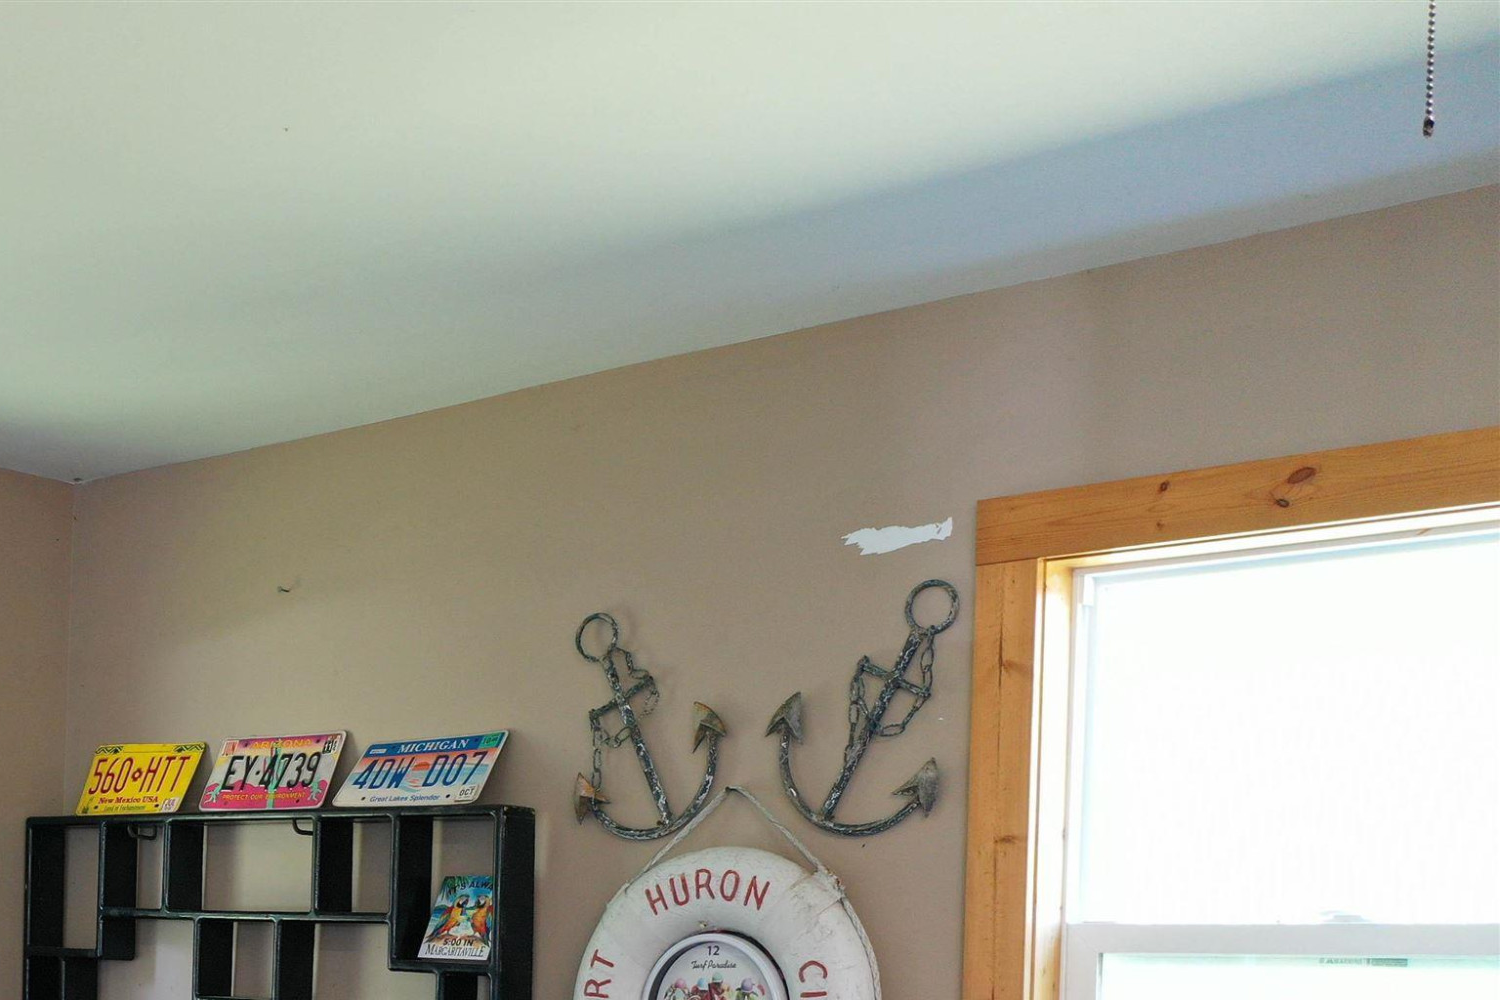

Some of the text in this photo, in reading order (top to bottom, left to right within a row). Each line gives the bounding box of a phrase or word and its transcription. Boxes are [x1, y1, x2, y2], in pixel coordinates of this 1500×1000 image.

[250, 739, 312, 749] ARIZONA
[397, 739, 469, 753] MICHIGAN
[352, 756, 415, 790] 4DW
[458, 788, 475, 797] OCT
[115, 796, 141, 804] Mexico
[410, 794, 441, 802] Splendor
[469, 881, 493, 890] ALWA
[644, 868, 771, 915] HURON
[443, 938, 461, 946] 5:00
[425, 944, 486, 957] MARGARITAVILLE
[707, 945, 720, 956] 12
[691, 960, 737, 970] Turf Paradise
